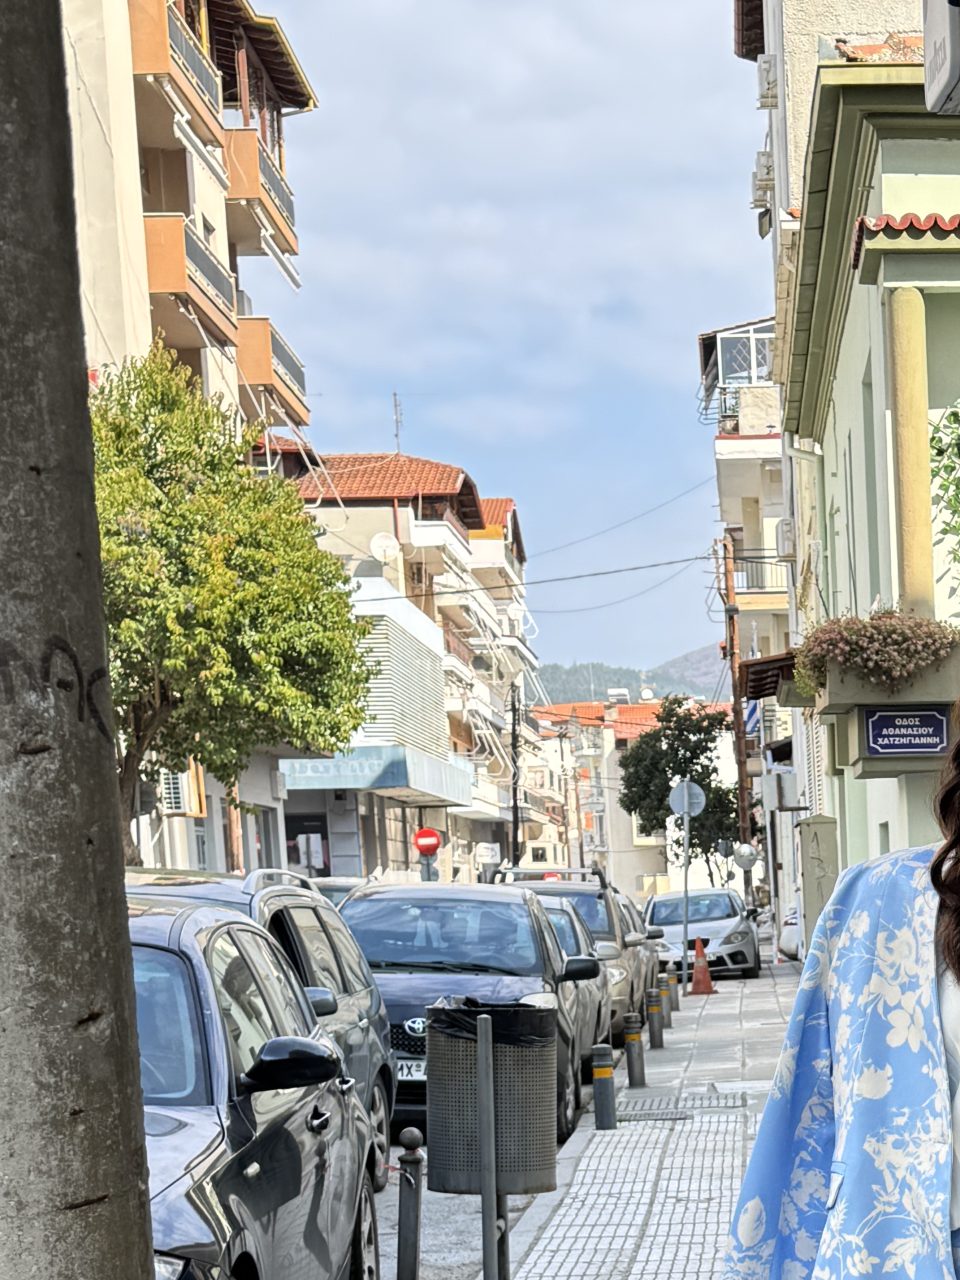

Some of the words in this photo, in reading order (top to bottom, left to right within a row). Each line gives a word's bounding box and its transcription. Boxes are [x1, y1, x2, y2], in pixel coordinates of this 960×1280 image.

[895, 718, 921, 726] ΟΔΟΣ
[881, 727, 935, 735] ΑΘΑΝΑΣΙΟΥ
[877, 736, 940, 745] ΧΑΤΖΗΓΙΑΝΝΗ
